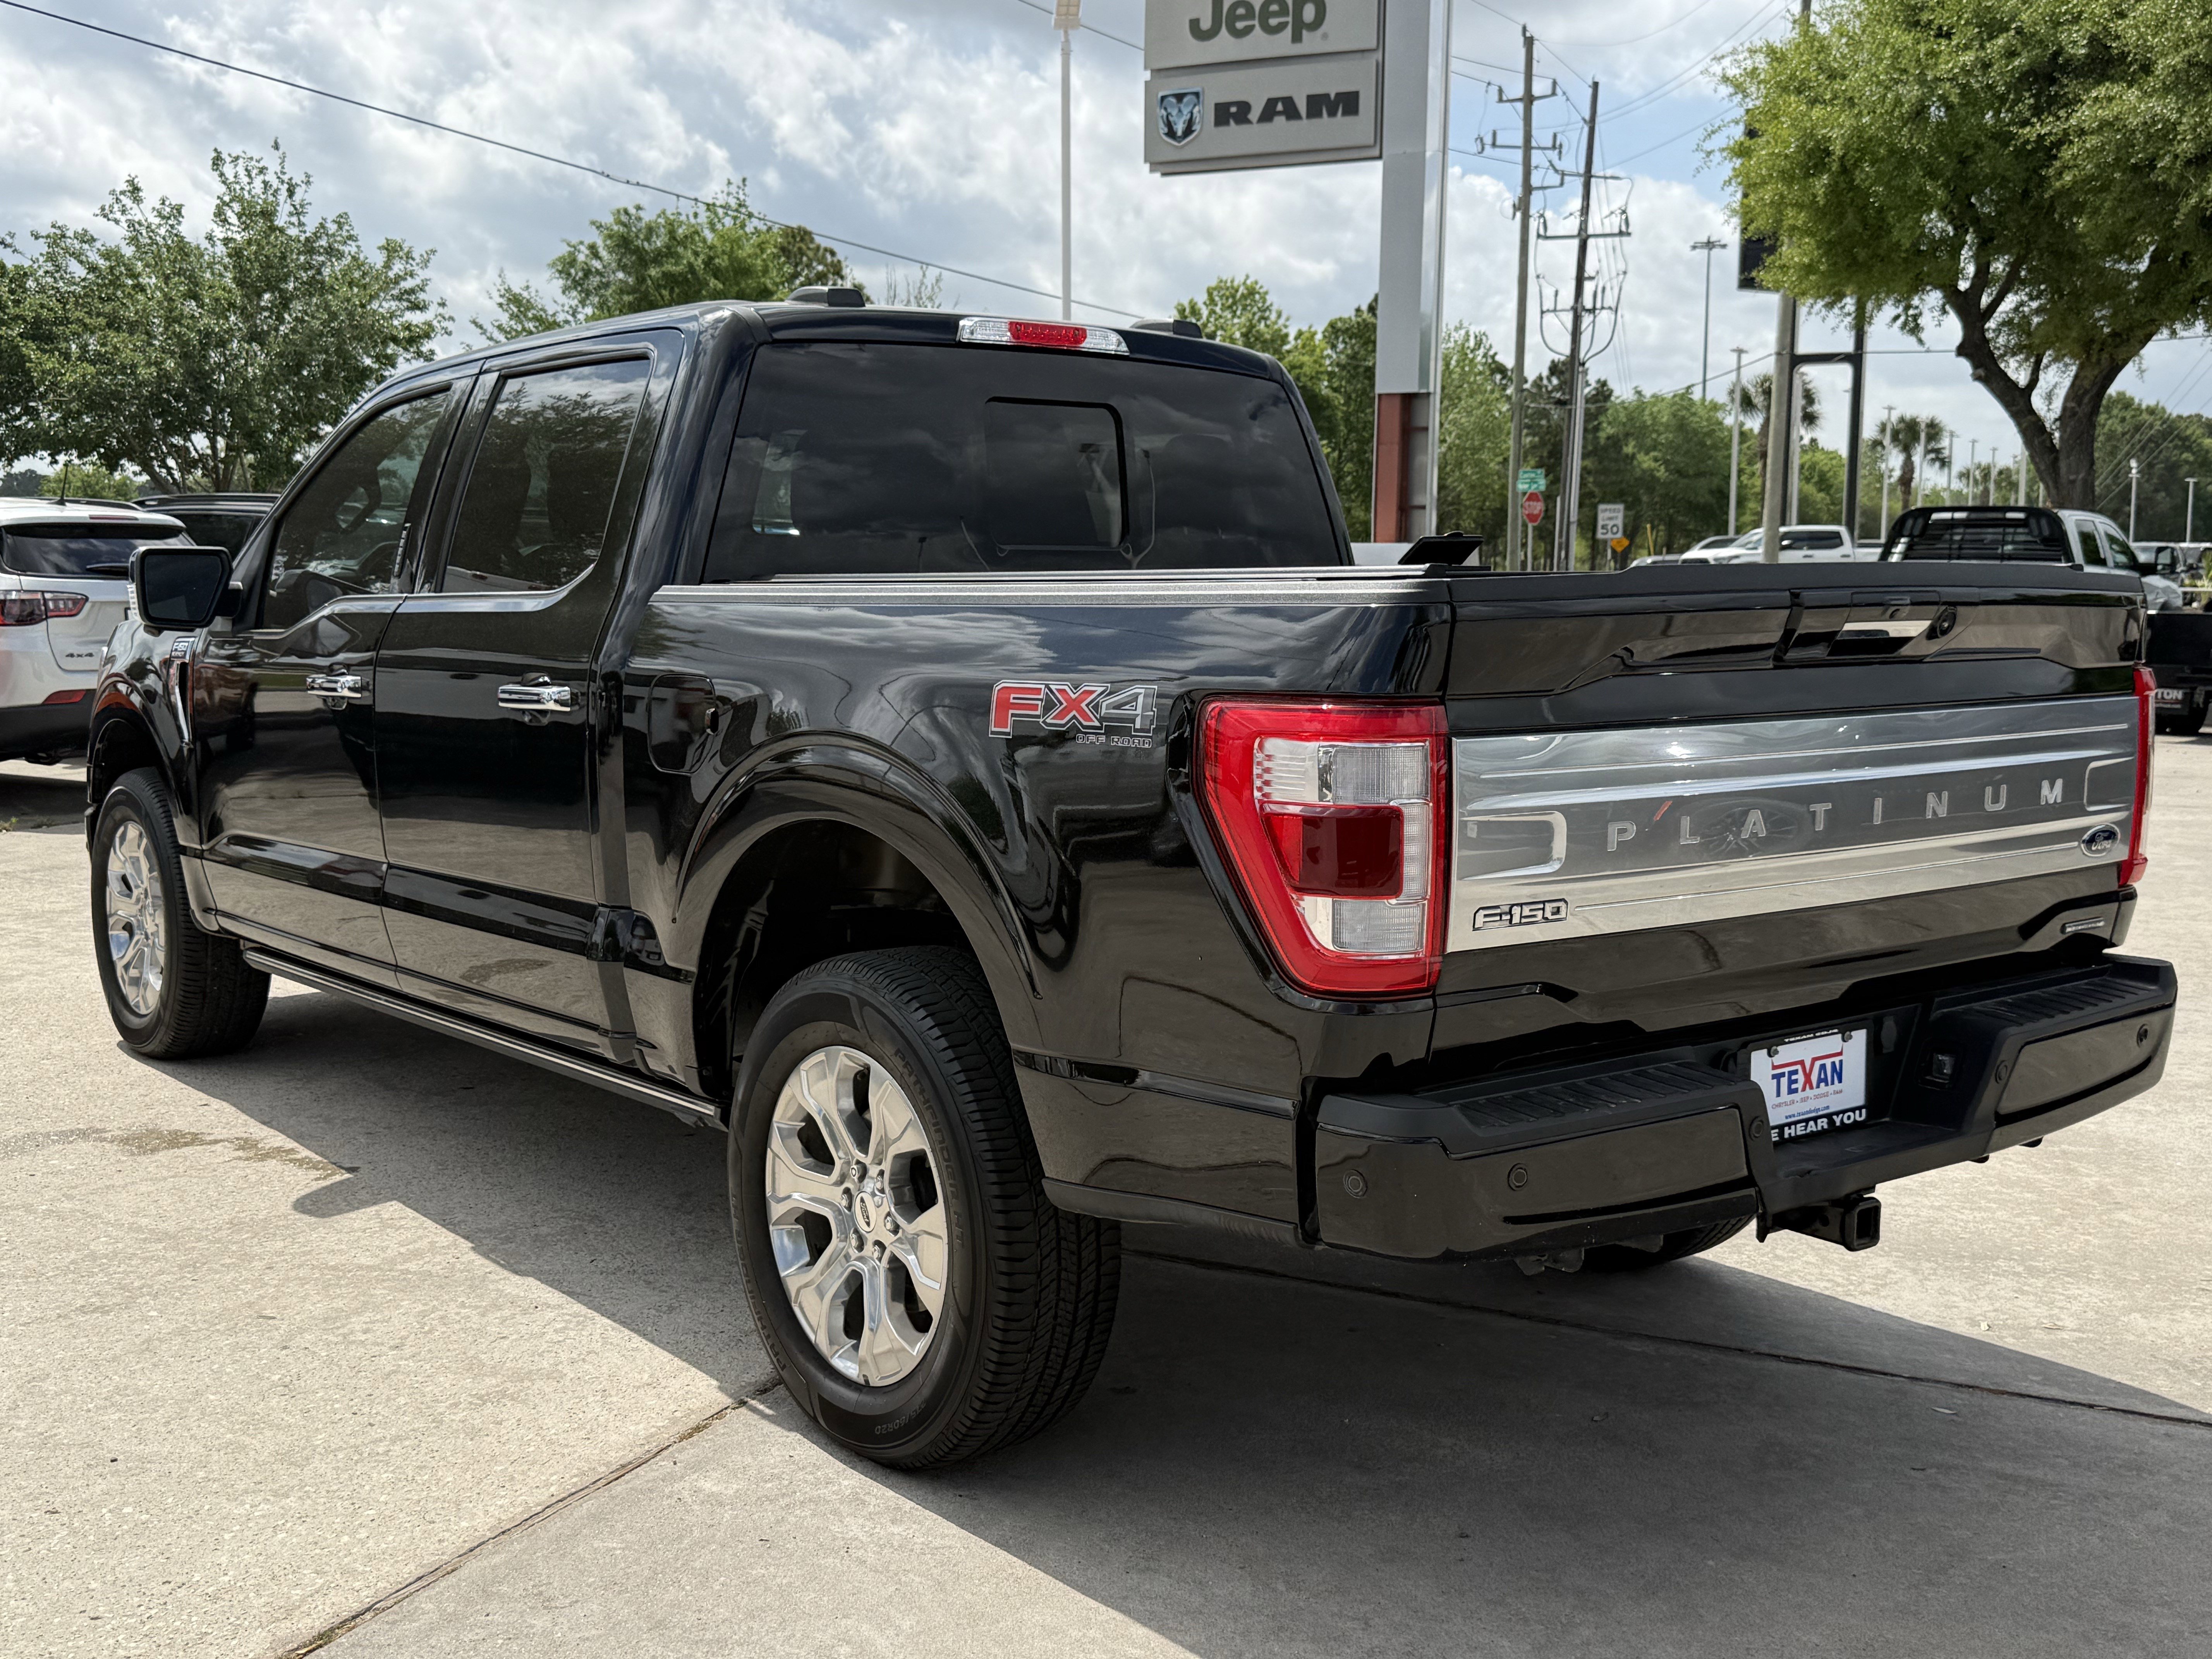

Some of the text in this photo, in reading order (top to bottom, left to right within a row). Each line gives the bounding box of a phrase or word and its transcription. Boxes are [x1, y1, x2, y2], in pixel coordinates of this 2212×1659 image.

[1189, 0, 1327, 43] Jeep
[1214, 91, 1360, 127] RAM
[1601, 524, 1619, 535] 50
[989, 679, 1158, 738] FX4
[1076, 734, 1152, 748] OFF ROAD
[1607, 778, 2063, 851] PLATINUM
[1472, 898, 1568, 931] F-150
[1771, 1055, 1843, 1098] TEXAN
[1784, 1118, 1828, 1139] HEAR
[1832, 1109, 1866, 1126] YOU
